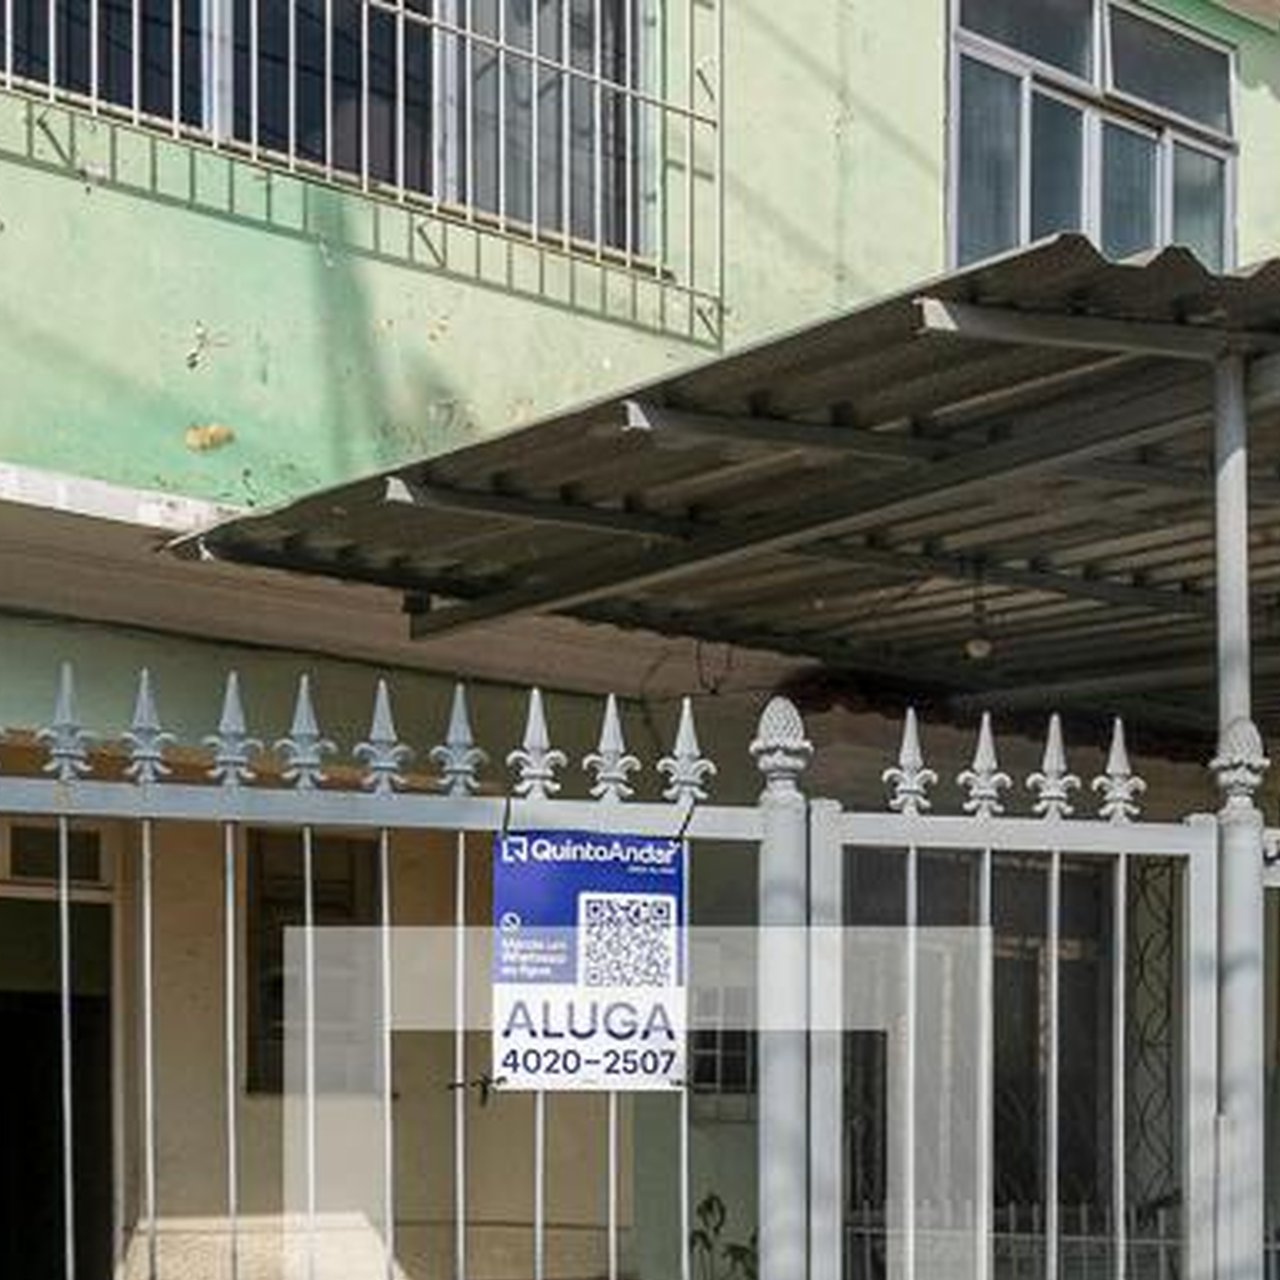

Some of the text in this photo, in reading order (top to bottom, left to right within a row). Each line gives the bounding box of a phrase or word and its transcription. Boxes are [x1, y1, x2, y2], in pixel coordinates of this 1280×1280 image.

[531, 840, 675, 864] QuintoAndar
[503, 1001, 676, 1041] ALUGA
[502, 1050, 676, 1075] 4020-2507
